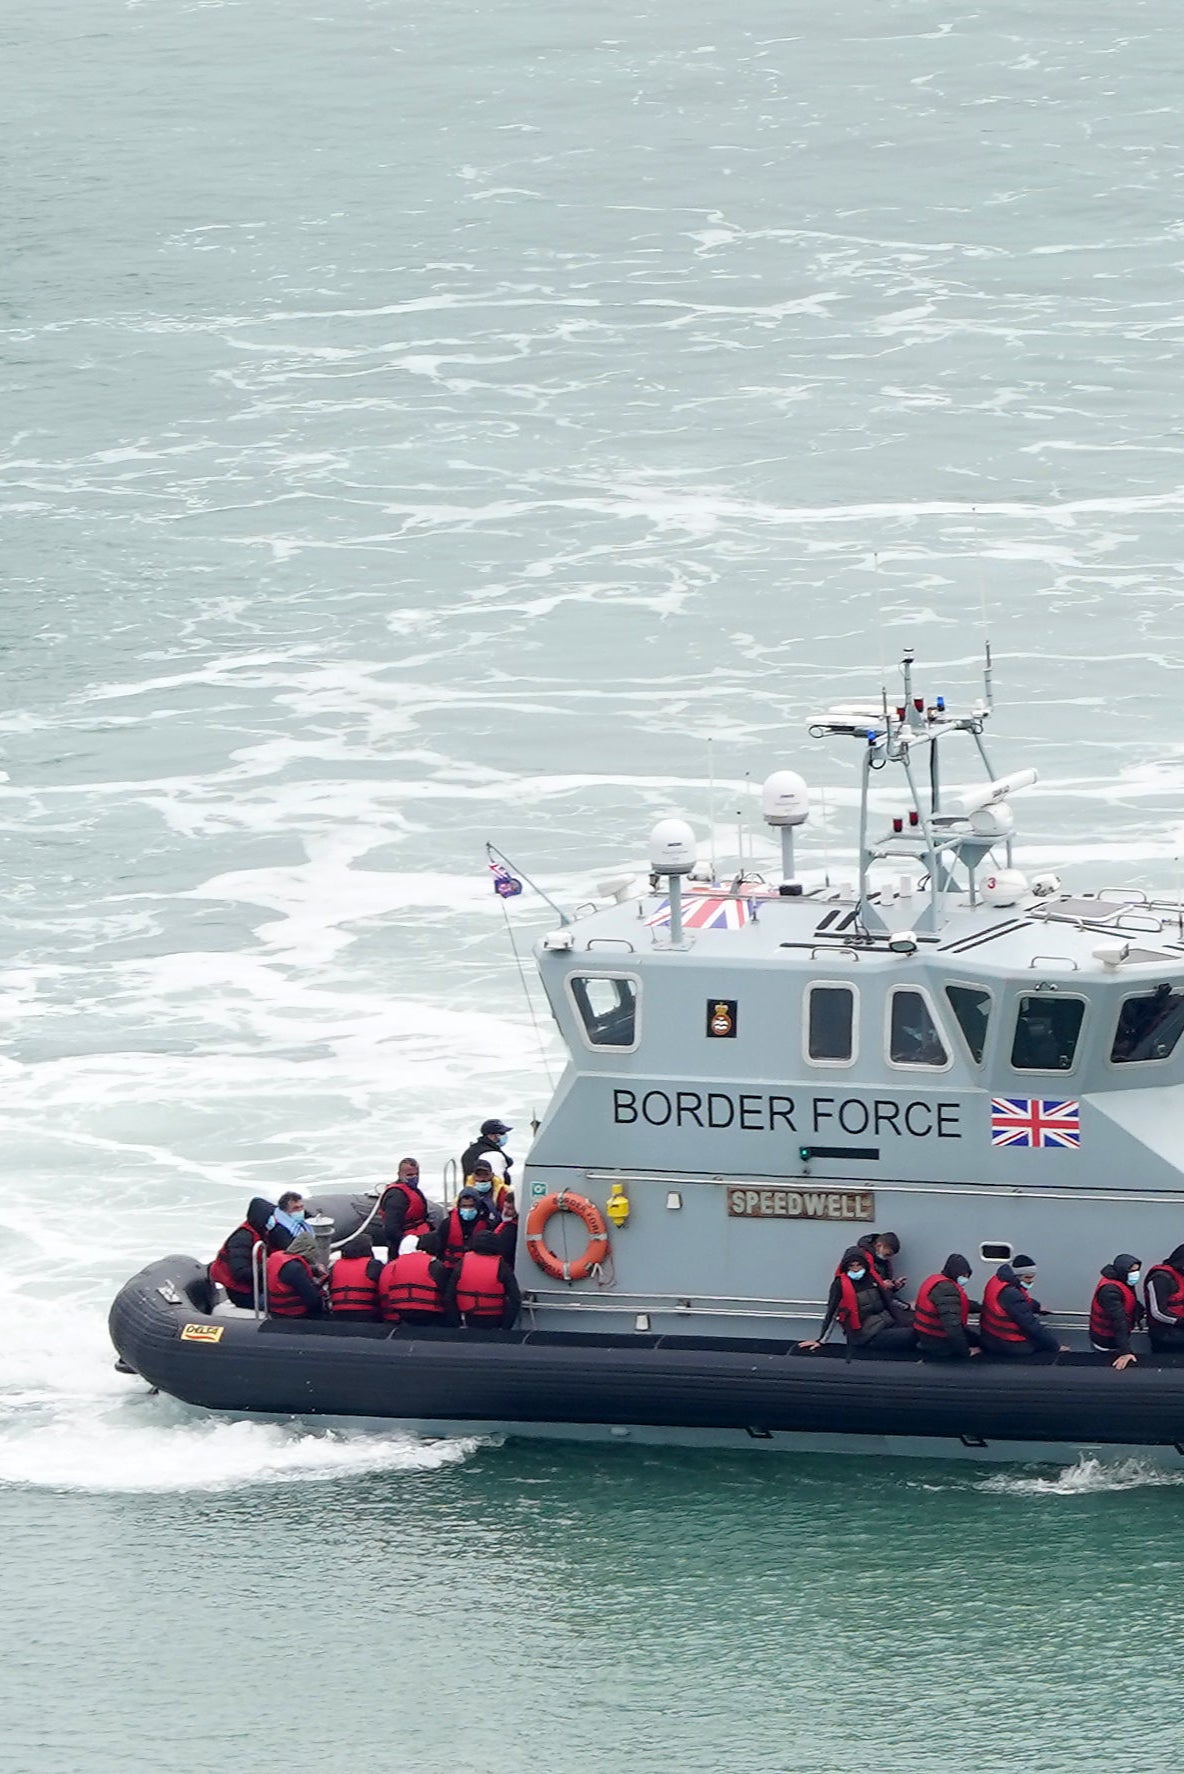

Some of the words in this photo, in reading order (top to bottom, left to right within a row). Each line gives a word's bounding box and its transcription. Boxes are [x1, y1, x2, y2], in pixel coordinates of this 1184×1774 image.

[987, 877, 996, 889] 3
[613, 1089, 797, 1132] BORDER
[813, 1098, 962, 1138] FORCE
[731, 1191, 870, 1218] SPEEDWELL
